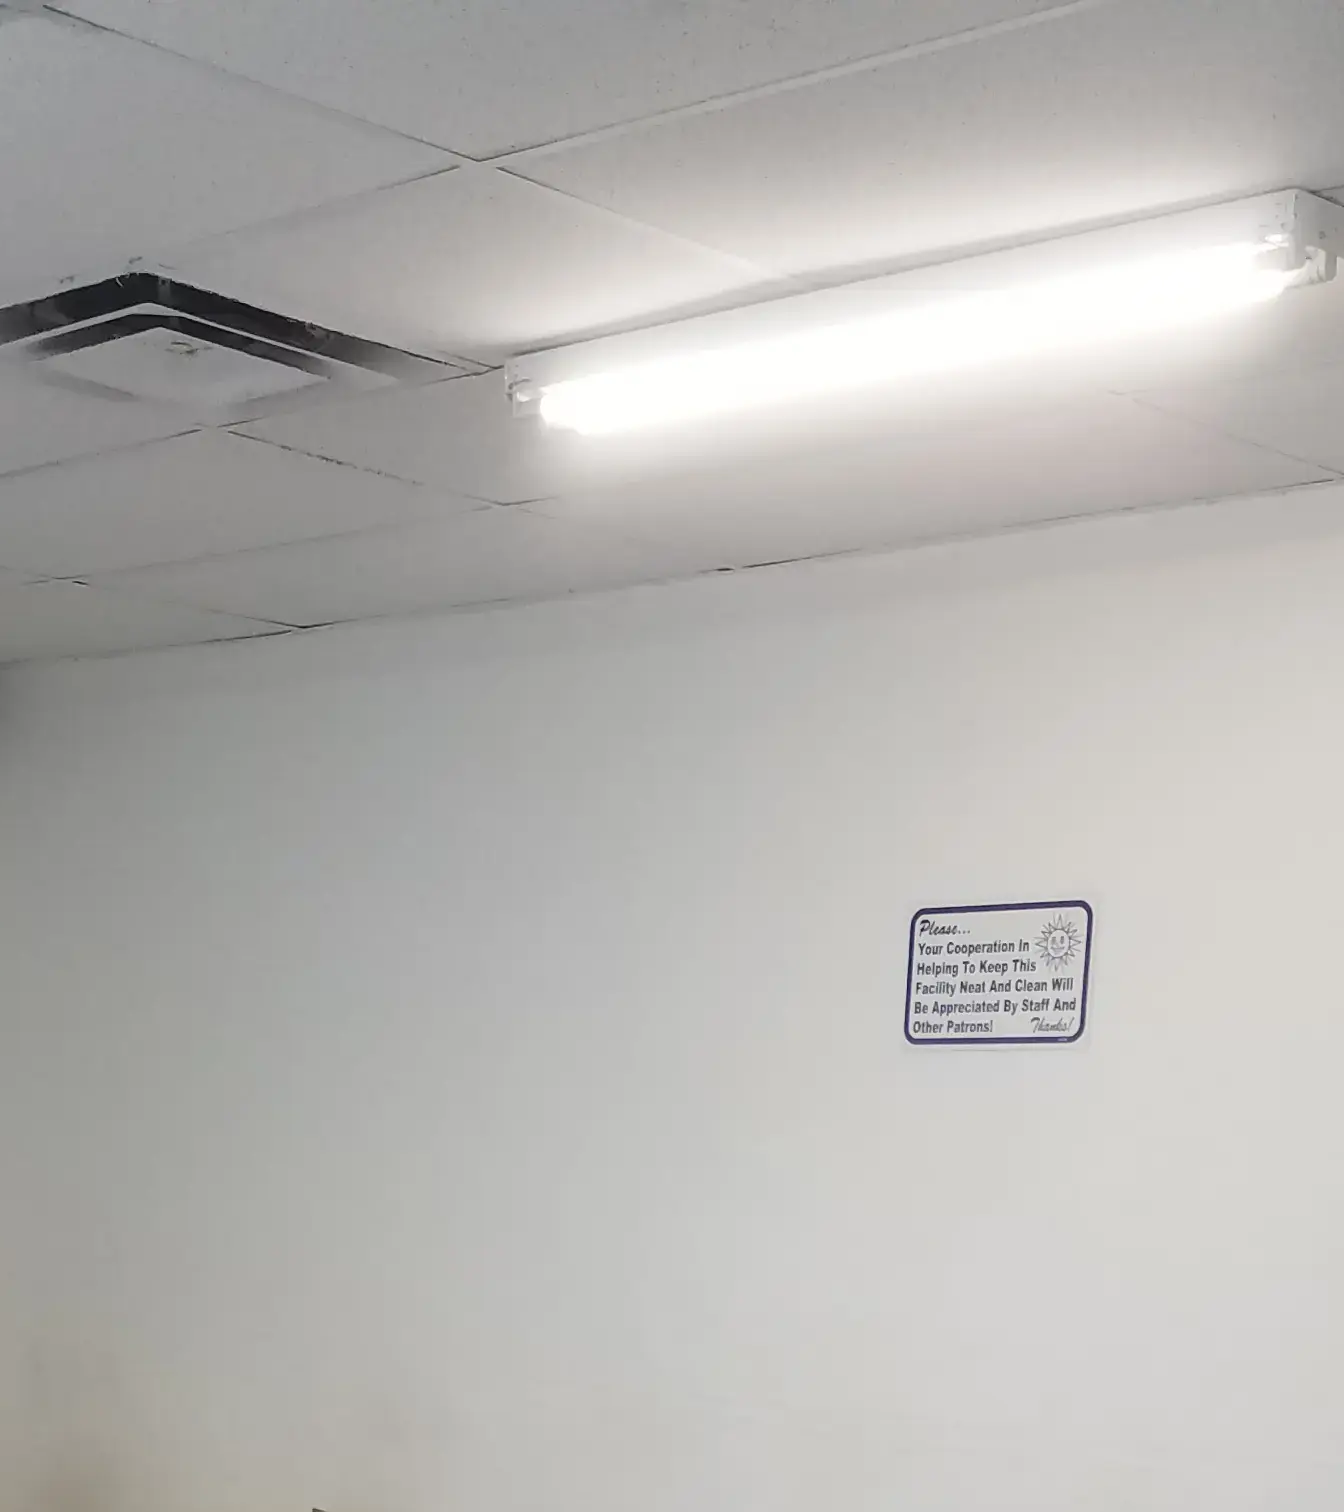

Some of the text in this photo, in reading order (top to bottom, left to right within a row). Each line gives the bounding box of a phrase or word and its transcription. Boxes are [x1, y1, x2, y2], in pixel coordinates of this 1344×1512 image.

[918, 919, 971, 937] Please...
[918, 939, 1030, 958] Your Cooperation In
[916, 959, 1037, 977] Helping To Keep This
[915, 977, 1074, 997] Facility Neat And Clean Will
[914, 997, 1077, 1016] Be Appreciated By Staff And
[912, 1019, 994, 1034] Other Patrons!
[1030, 1016, 1075, 1033] Thanks!
